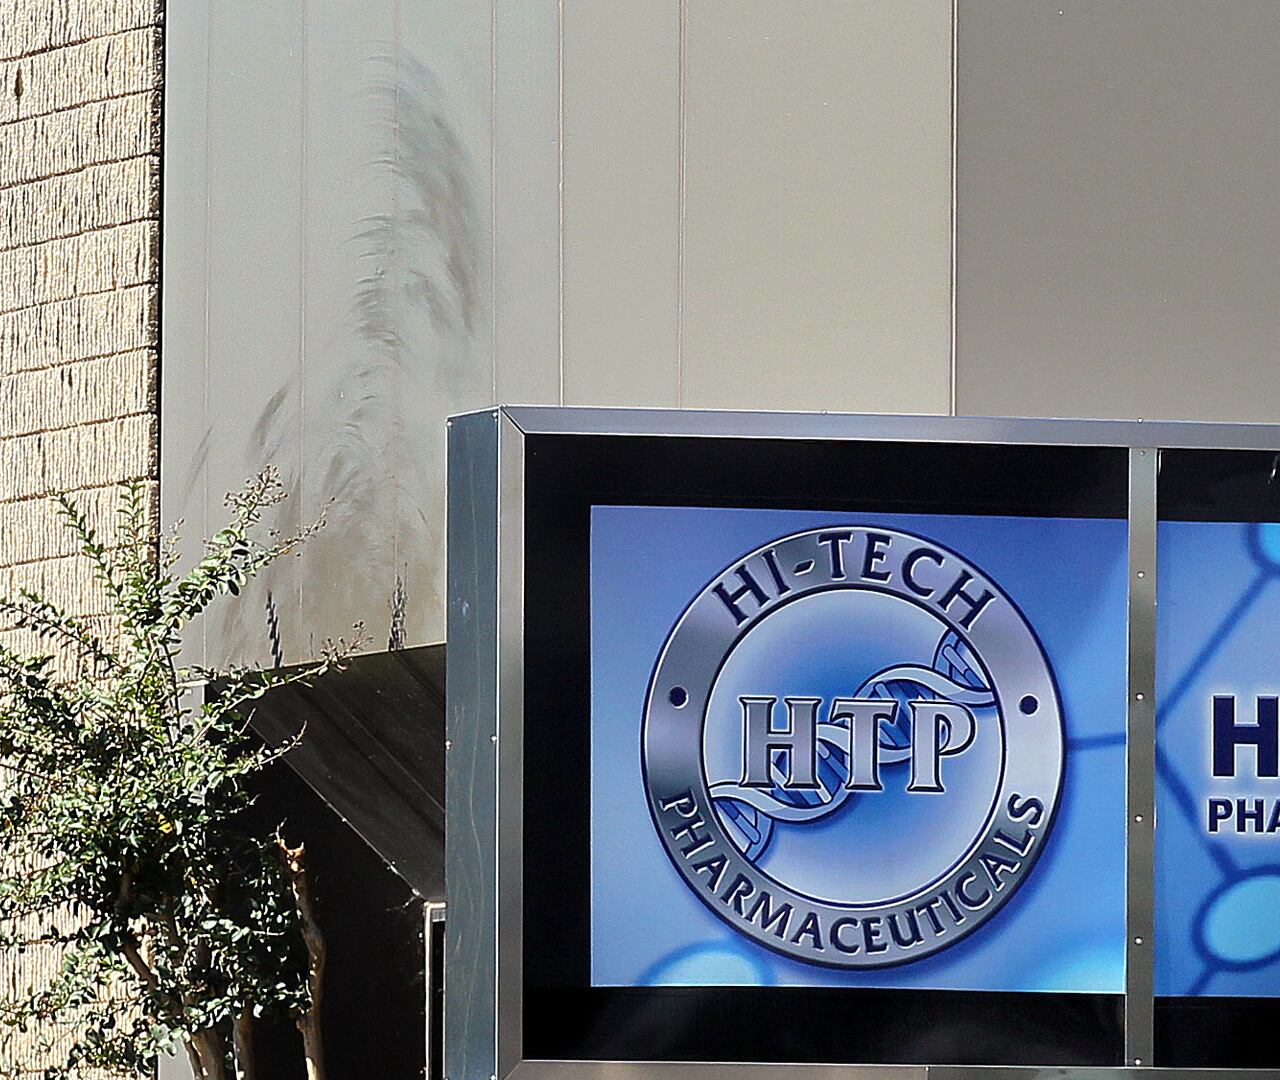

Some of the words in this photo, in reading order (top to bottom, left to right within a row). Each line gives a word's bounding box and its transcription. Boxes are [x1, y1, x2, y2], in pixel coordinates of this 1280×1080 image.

[712, 531, 996, 631] HI-TECH
[738, 696, 976, 793] HTP
[659, 788, 1045, 955] PHARMACEUTICALS
